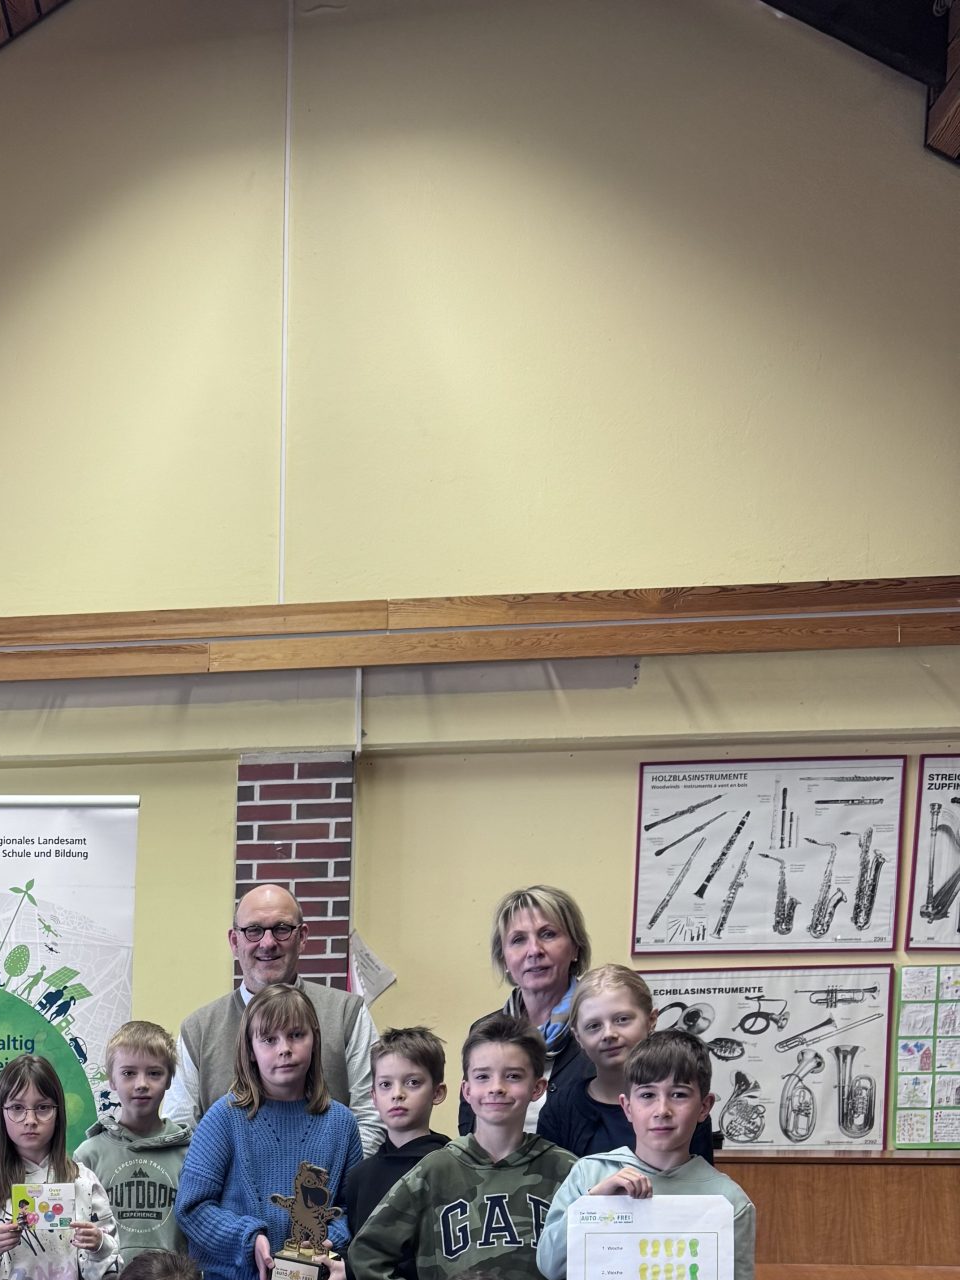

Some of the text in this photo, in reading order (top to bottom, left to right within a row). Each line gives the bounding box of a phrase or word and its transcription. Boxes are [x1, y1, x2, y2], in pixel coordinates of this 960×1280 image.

[651, 773, 748, 782] HOLZBLASINSTRUMENTE
[38, 836, 87, 845] Landesamt
[2, 849, 31, 857] Schule
[34, 849, 52, 857] und
[54, 849, 88, 860] Bildung
[653, 986, 764, 996] ECHBLASINSTRUMENTE
